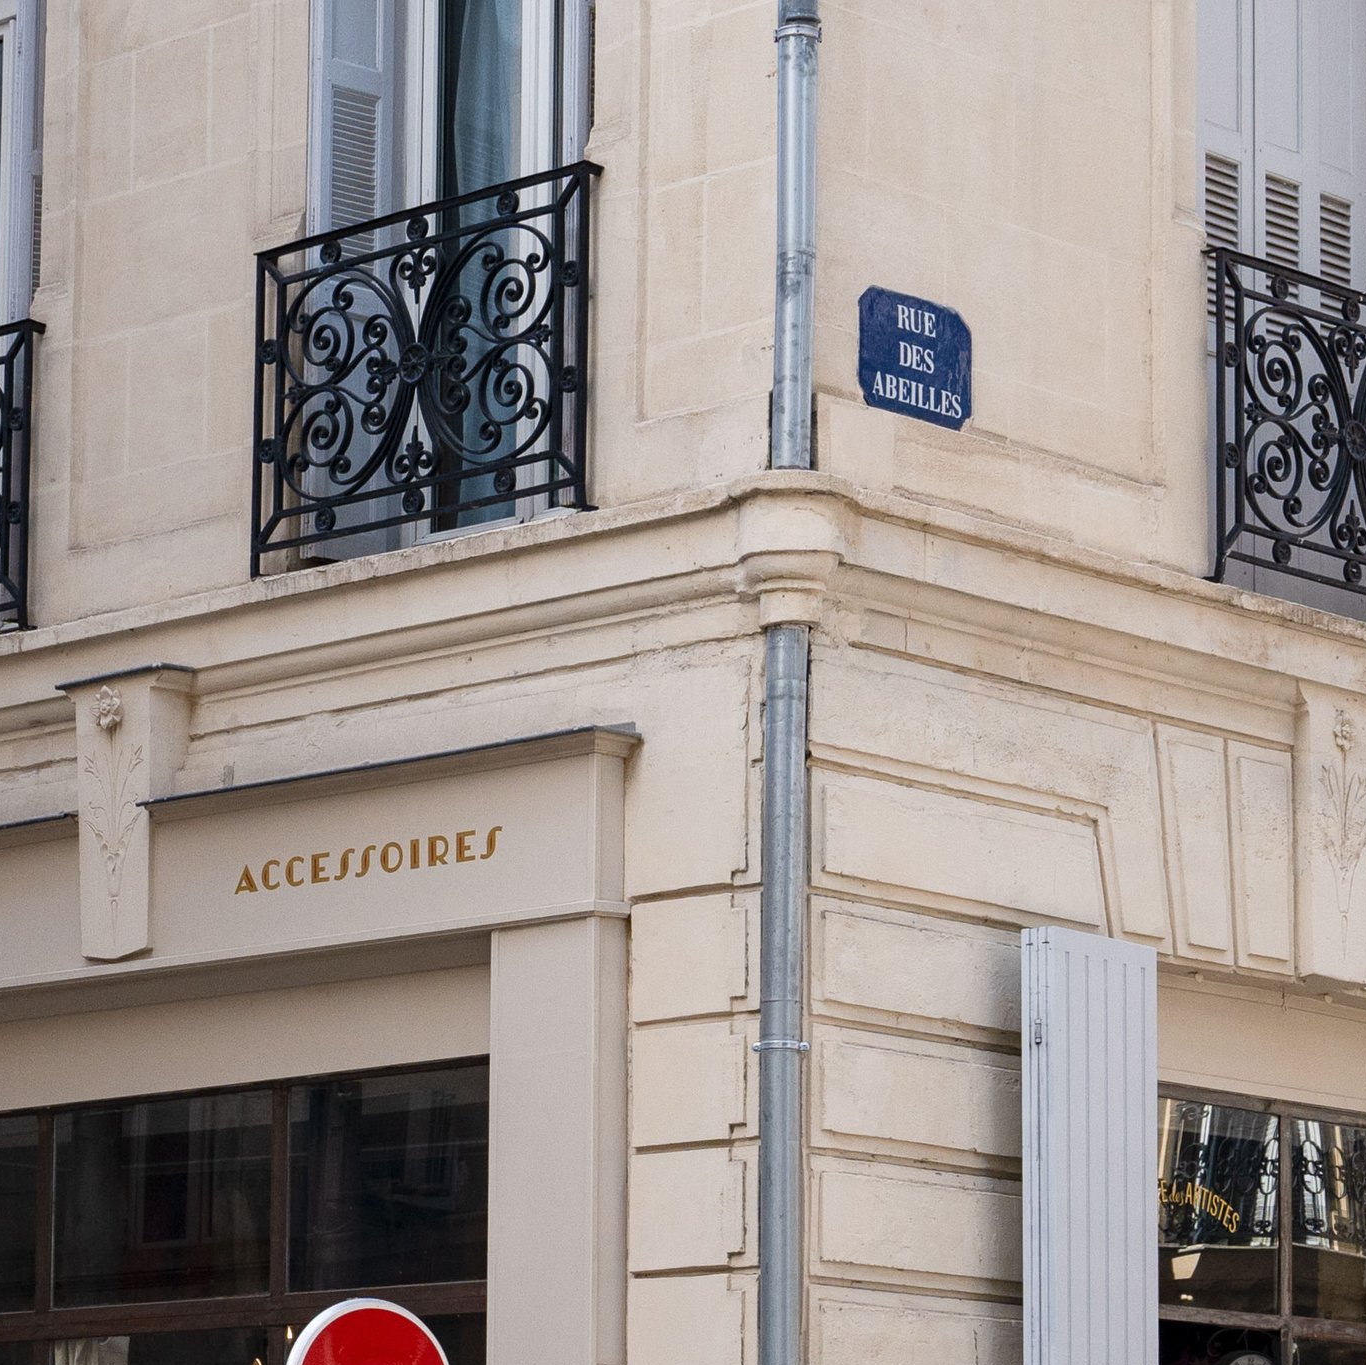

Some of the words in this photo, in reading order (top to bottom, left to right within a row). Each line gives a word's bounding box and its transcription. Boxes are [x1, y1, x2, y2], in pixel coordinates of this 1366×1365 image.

[896, 303, 936, 338] RUE
[898, 341, 935, 374] DES
[872, 370, 963, 419] ABEILLES
[234, 825, 503, 895] ACCESSOIRES
[1185, 1182, 1240, 1234] ARTISTES
